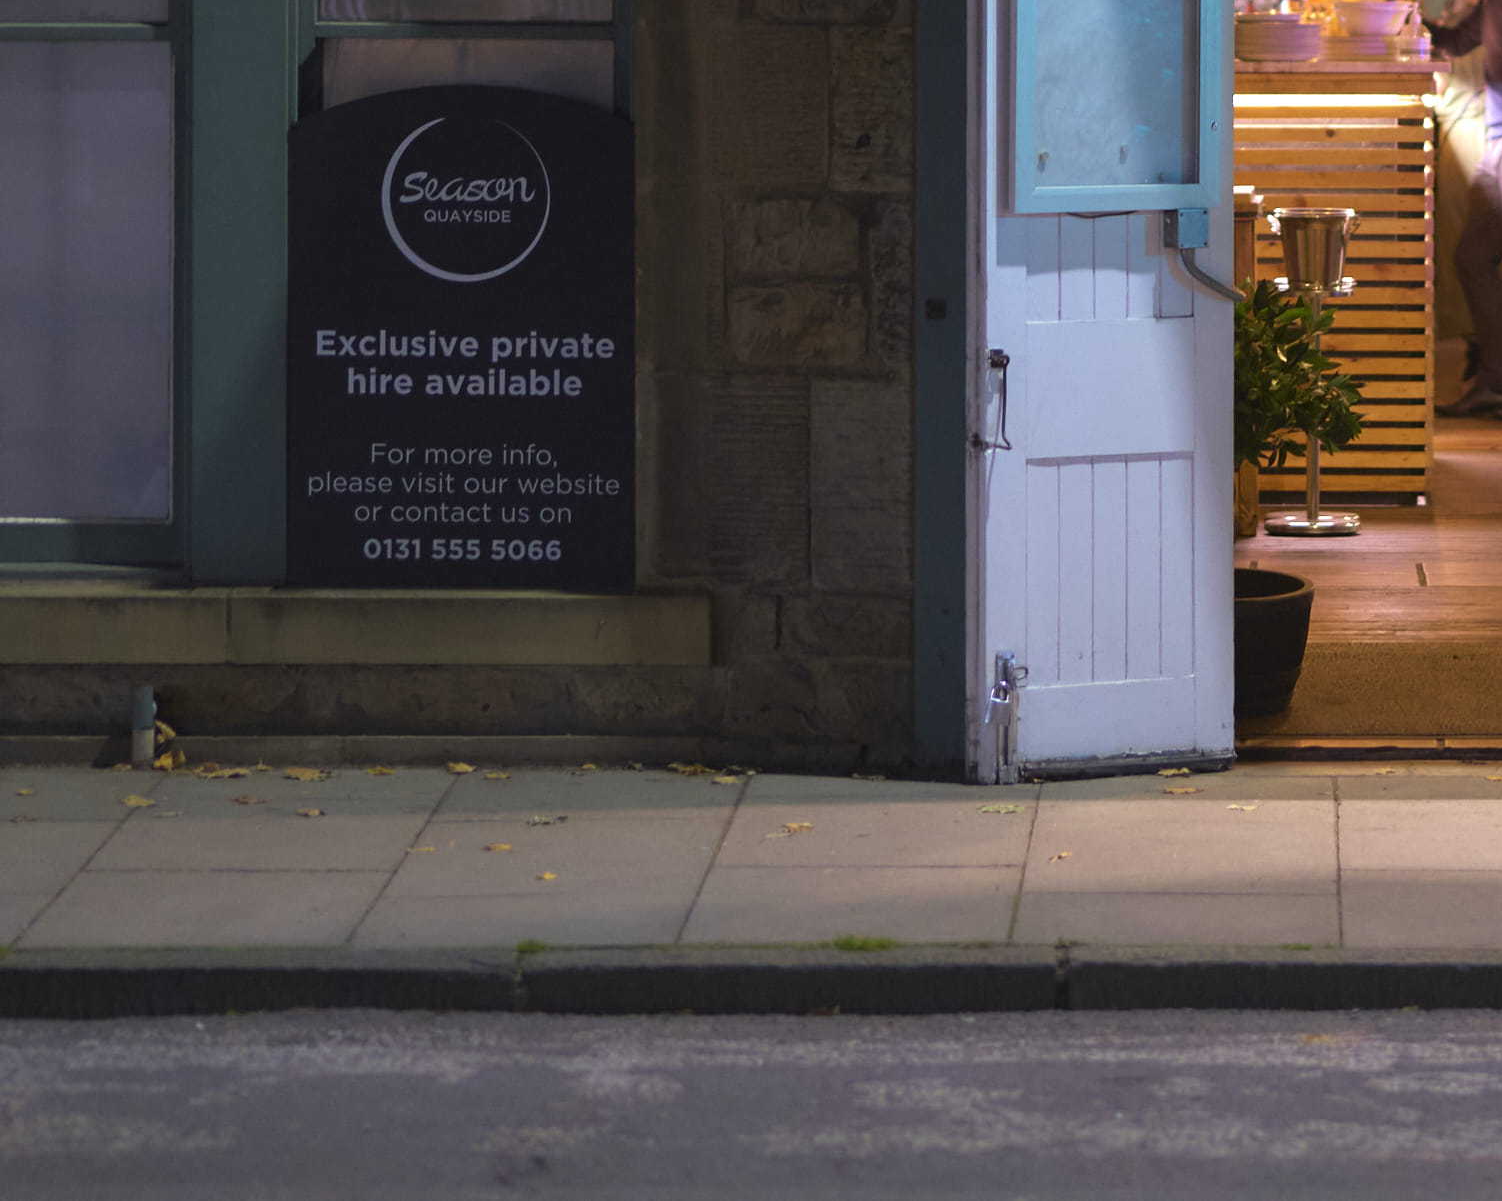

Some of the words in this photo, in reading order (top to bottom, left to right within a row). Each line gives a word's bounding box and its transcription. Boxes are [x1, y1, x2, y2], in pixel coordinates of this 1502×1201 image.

[399, 171, 536, 204] Season
[423, 209, 511, 223] QUAYSIDE
[316, 329, 479, 358] Exclusive
[491, 330, 615, 362] private
[347, 367, 413, 395] hire
[425, 368, 582, 397] available
[371, 442, 416, 464] For
[424, 448, 493, 465] more
[503, 443, 558, 468] info,
[308, 470, 393, 496] please
[401, 471, 455, 494] visit
[463, 477, 508, 494] our
[517, 472, 620, 495] website
[354, 505, 382, 522] or
[390, 502, 492, 523] contact
[501, 506, 530, 524] us
[539, 507, 572, 524] on
[363, 538, 421, 560] 0131
[431, 539, 481, 560] 555
[491, 539, 562, 561] 5066
